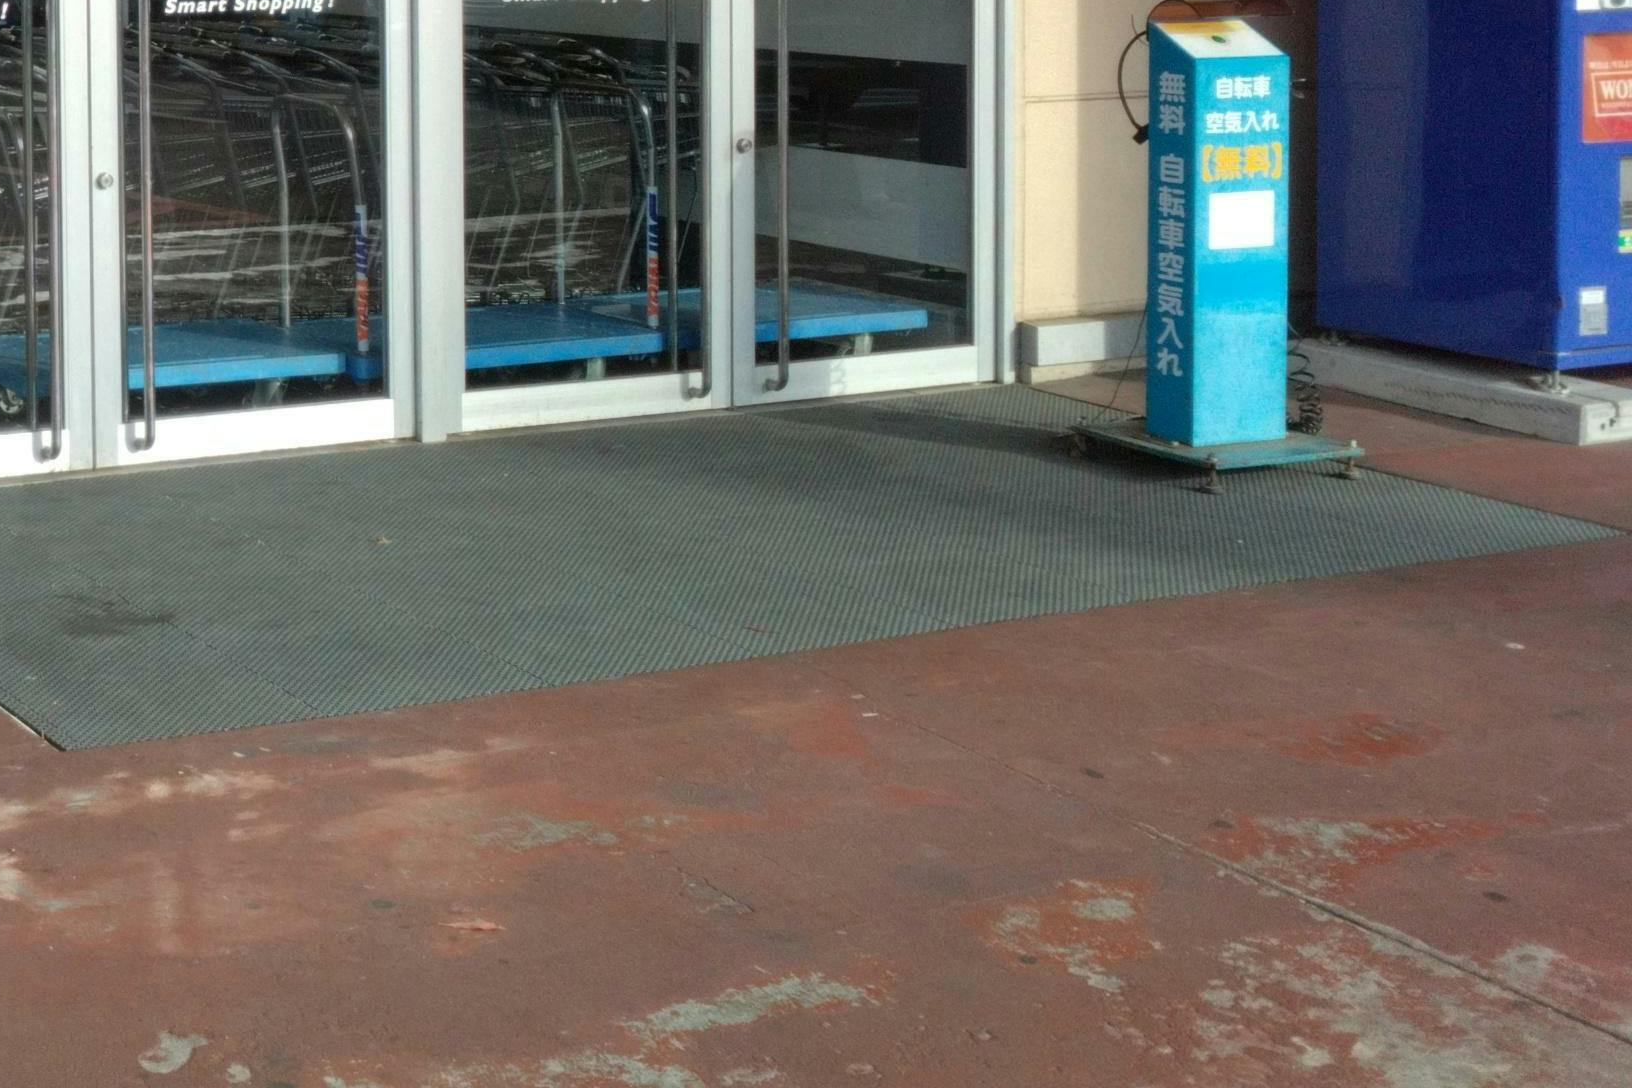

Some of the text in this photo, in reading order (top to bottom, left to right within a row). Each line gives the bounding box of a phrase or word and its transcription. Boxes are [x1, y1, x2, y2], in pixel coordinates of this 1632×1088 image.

[1158, 70, 1187, 136] 無料
[1215, 75, 1272, 101] 自転車
[1205, 109, 1280, 135] 空気入れ
[1155, 152, 1186, 378] 自転車空気入れ
